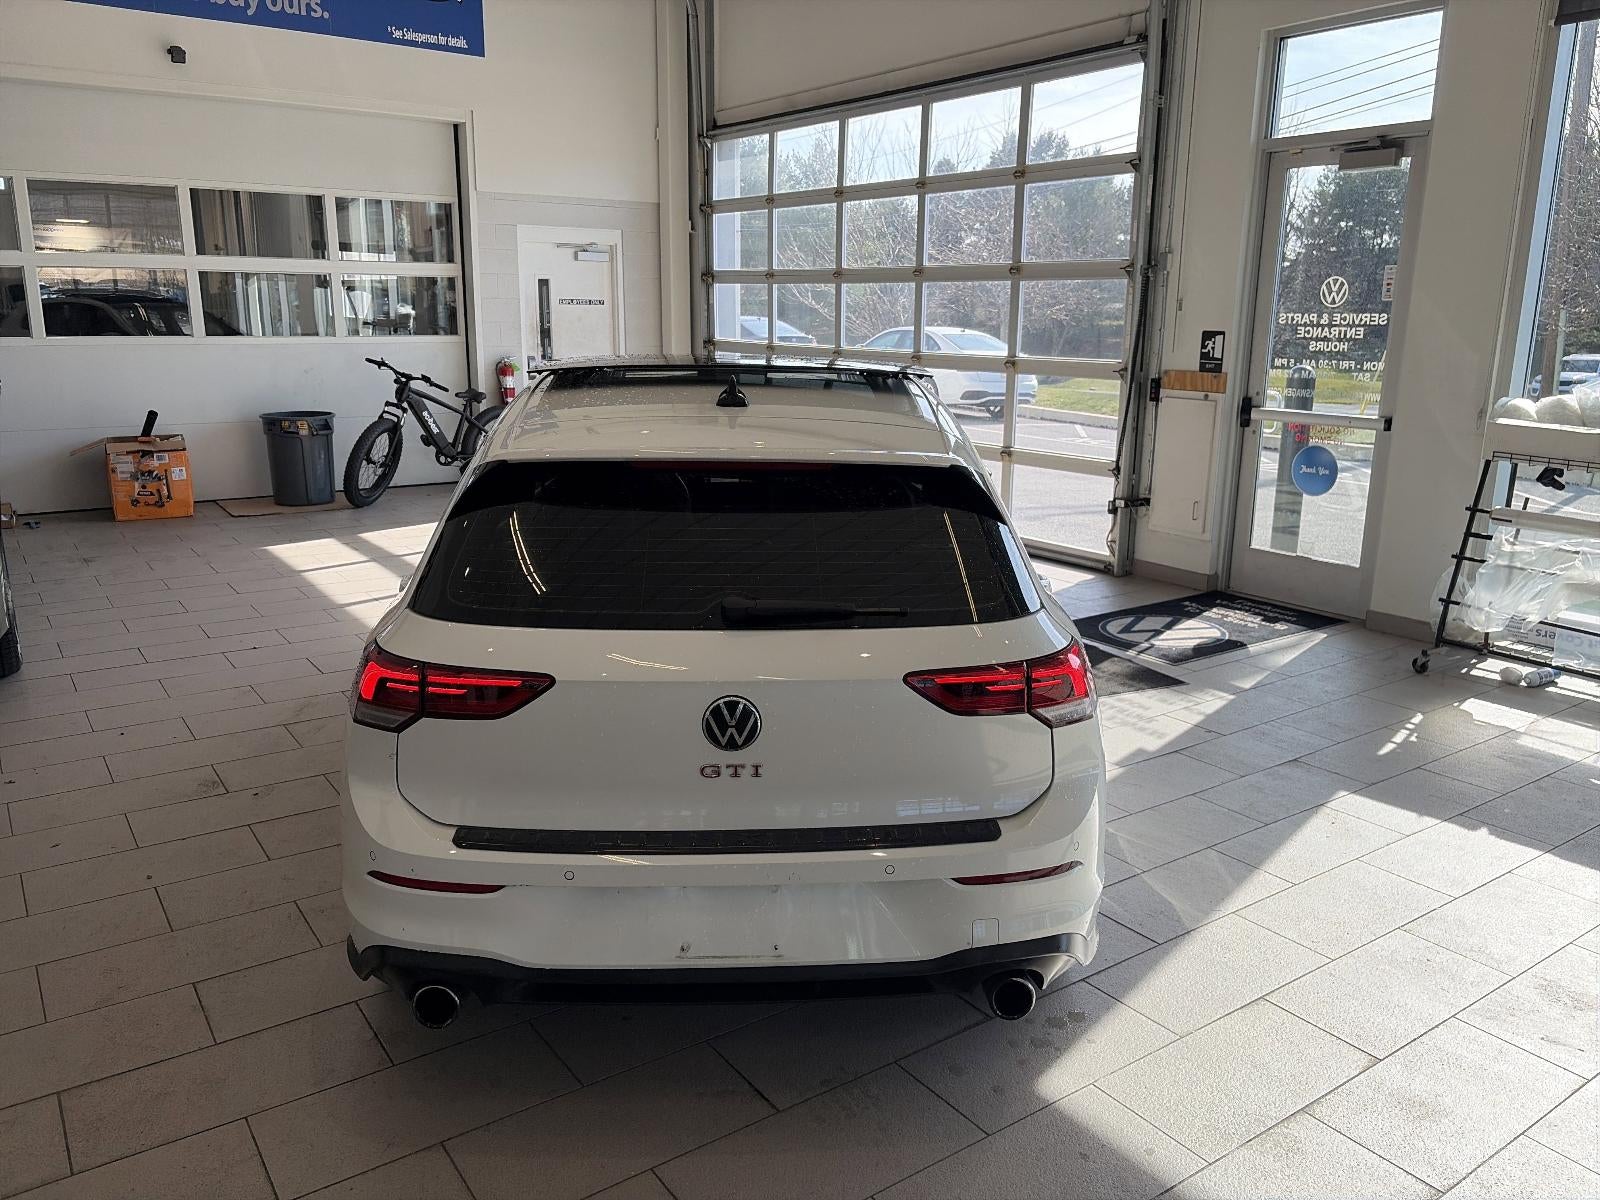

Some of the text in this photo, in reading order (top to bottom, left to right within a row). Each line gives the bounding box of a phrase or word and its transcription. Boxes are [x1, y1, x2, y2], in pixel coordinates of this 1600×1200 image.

[392, 26, 403, 39] See
[404, 28, 437, 44] Salesperson
[438, 33, 447, 45] for
[448, 34, 468, 48] details.
[1299, 464, 1330, 476] Thank You
[700, 764, 763, 778] GTI
